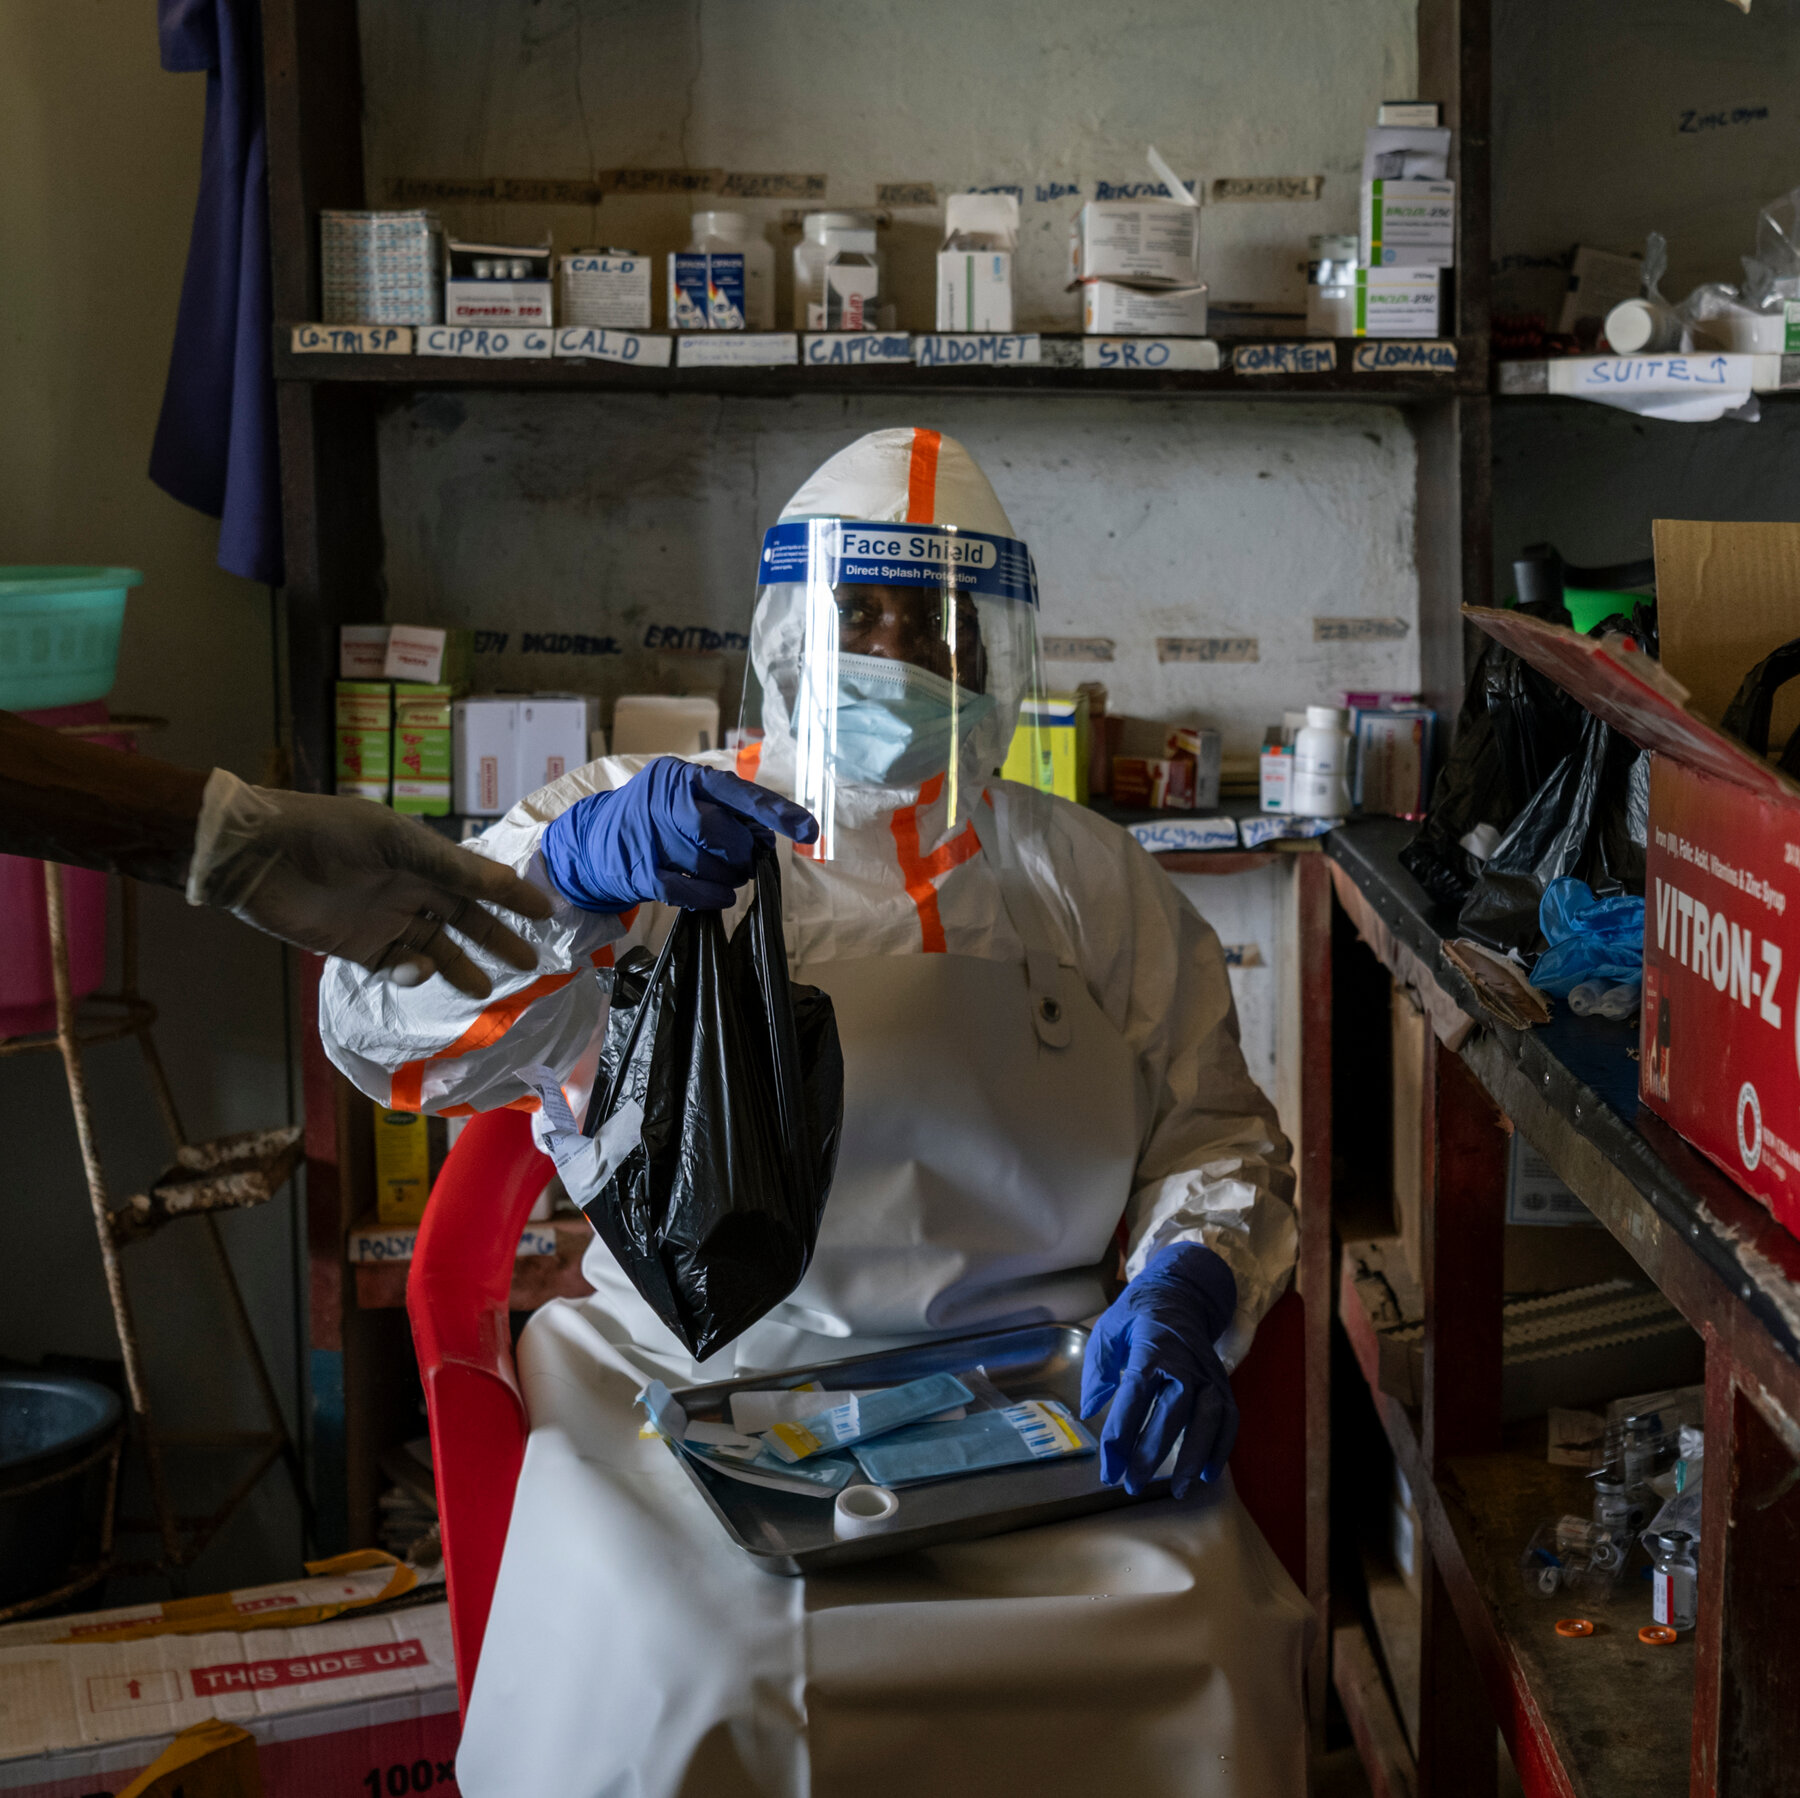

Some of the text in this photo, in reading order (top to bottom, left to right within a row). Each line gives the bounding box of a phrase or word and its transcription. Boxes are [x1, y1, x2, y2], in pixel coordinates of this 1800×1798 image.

[571, 258, 635, 274] CAL-D
[429, 328, 509, 355] CIPRO
[917, 335, 1038, 366] ALDOMET
[1099, 341, 1170, 367] SRO
[1585, 359, 1689, 385] SUITE
[843, 533, 984, 564] Face Shield
[846, 564, 977, 585] Direct Splash Prottion
[1655, 877, 1782, 1030] VITRON-Z
[202, 1646, 419, 1687] THIS SIDE UP
